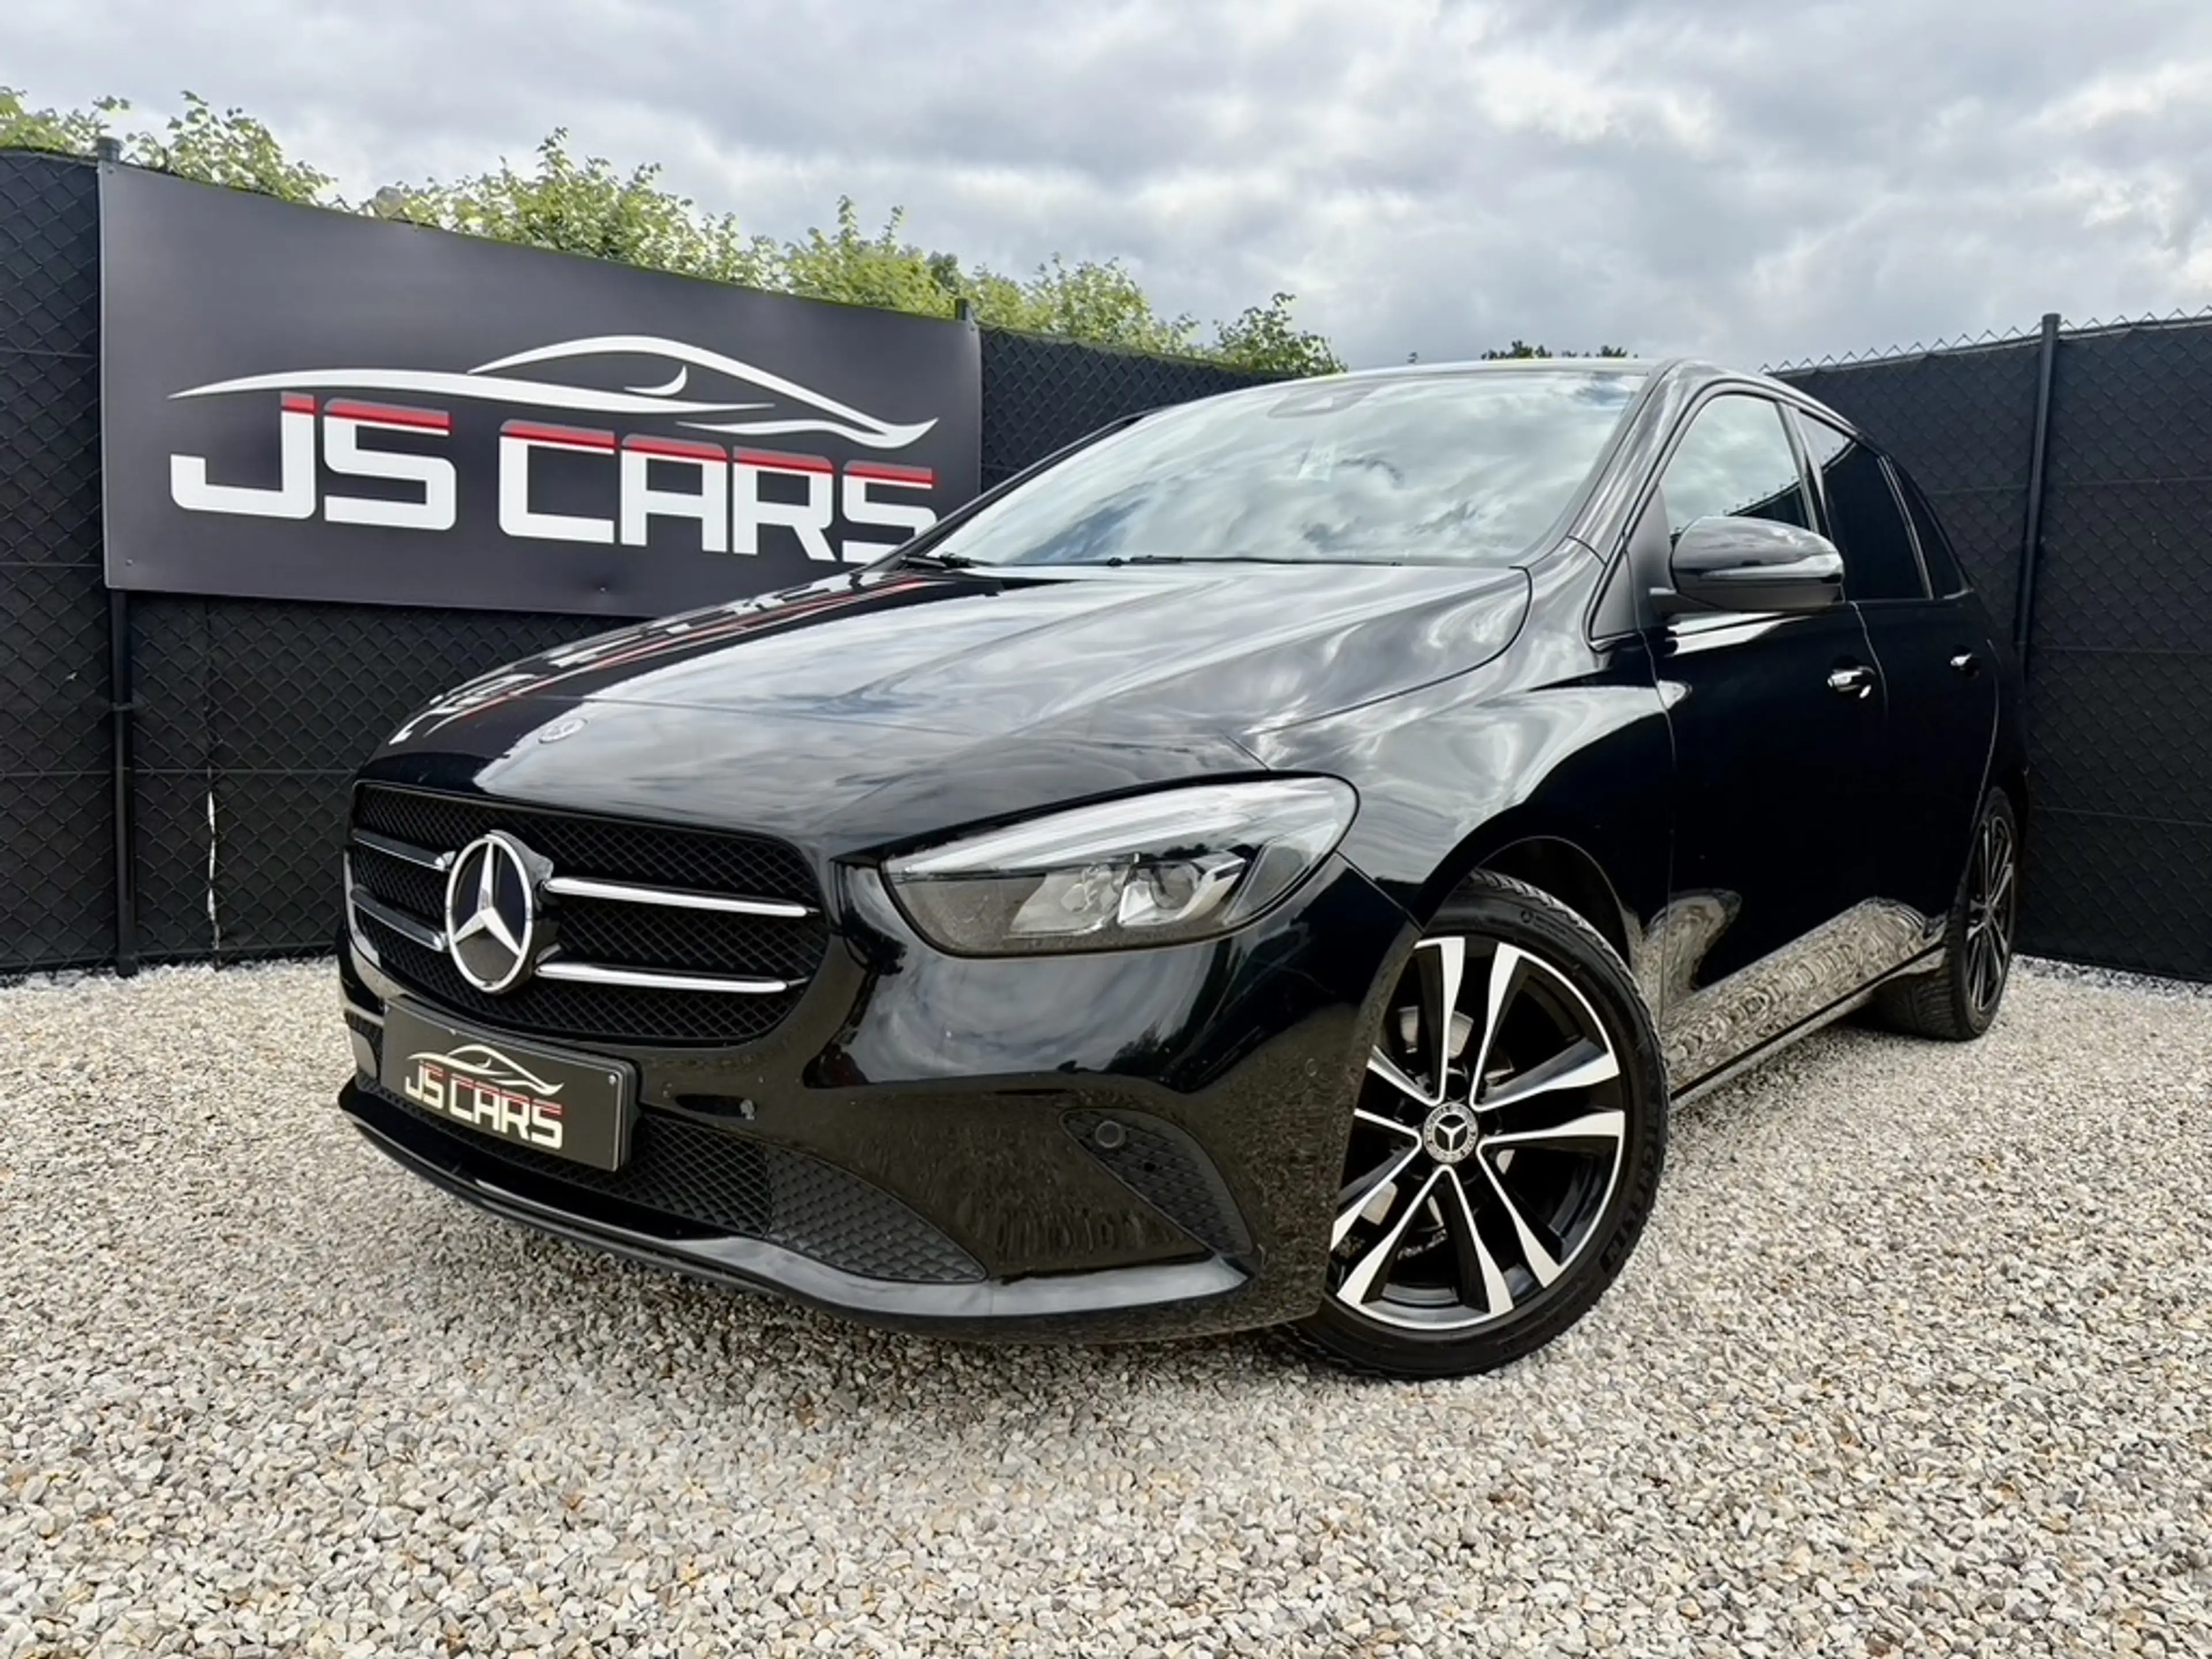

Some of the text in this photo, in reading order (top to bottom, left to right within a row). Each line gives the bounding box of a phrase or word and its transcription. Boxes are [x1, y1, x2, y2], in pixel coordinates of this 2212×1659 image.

[171, 391, 938, 564] JS CARS
[405, 1060, 563, 1149] JS CARS
